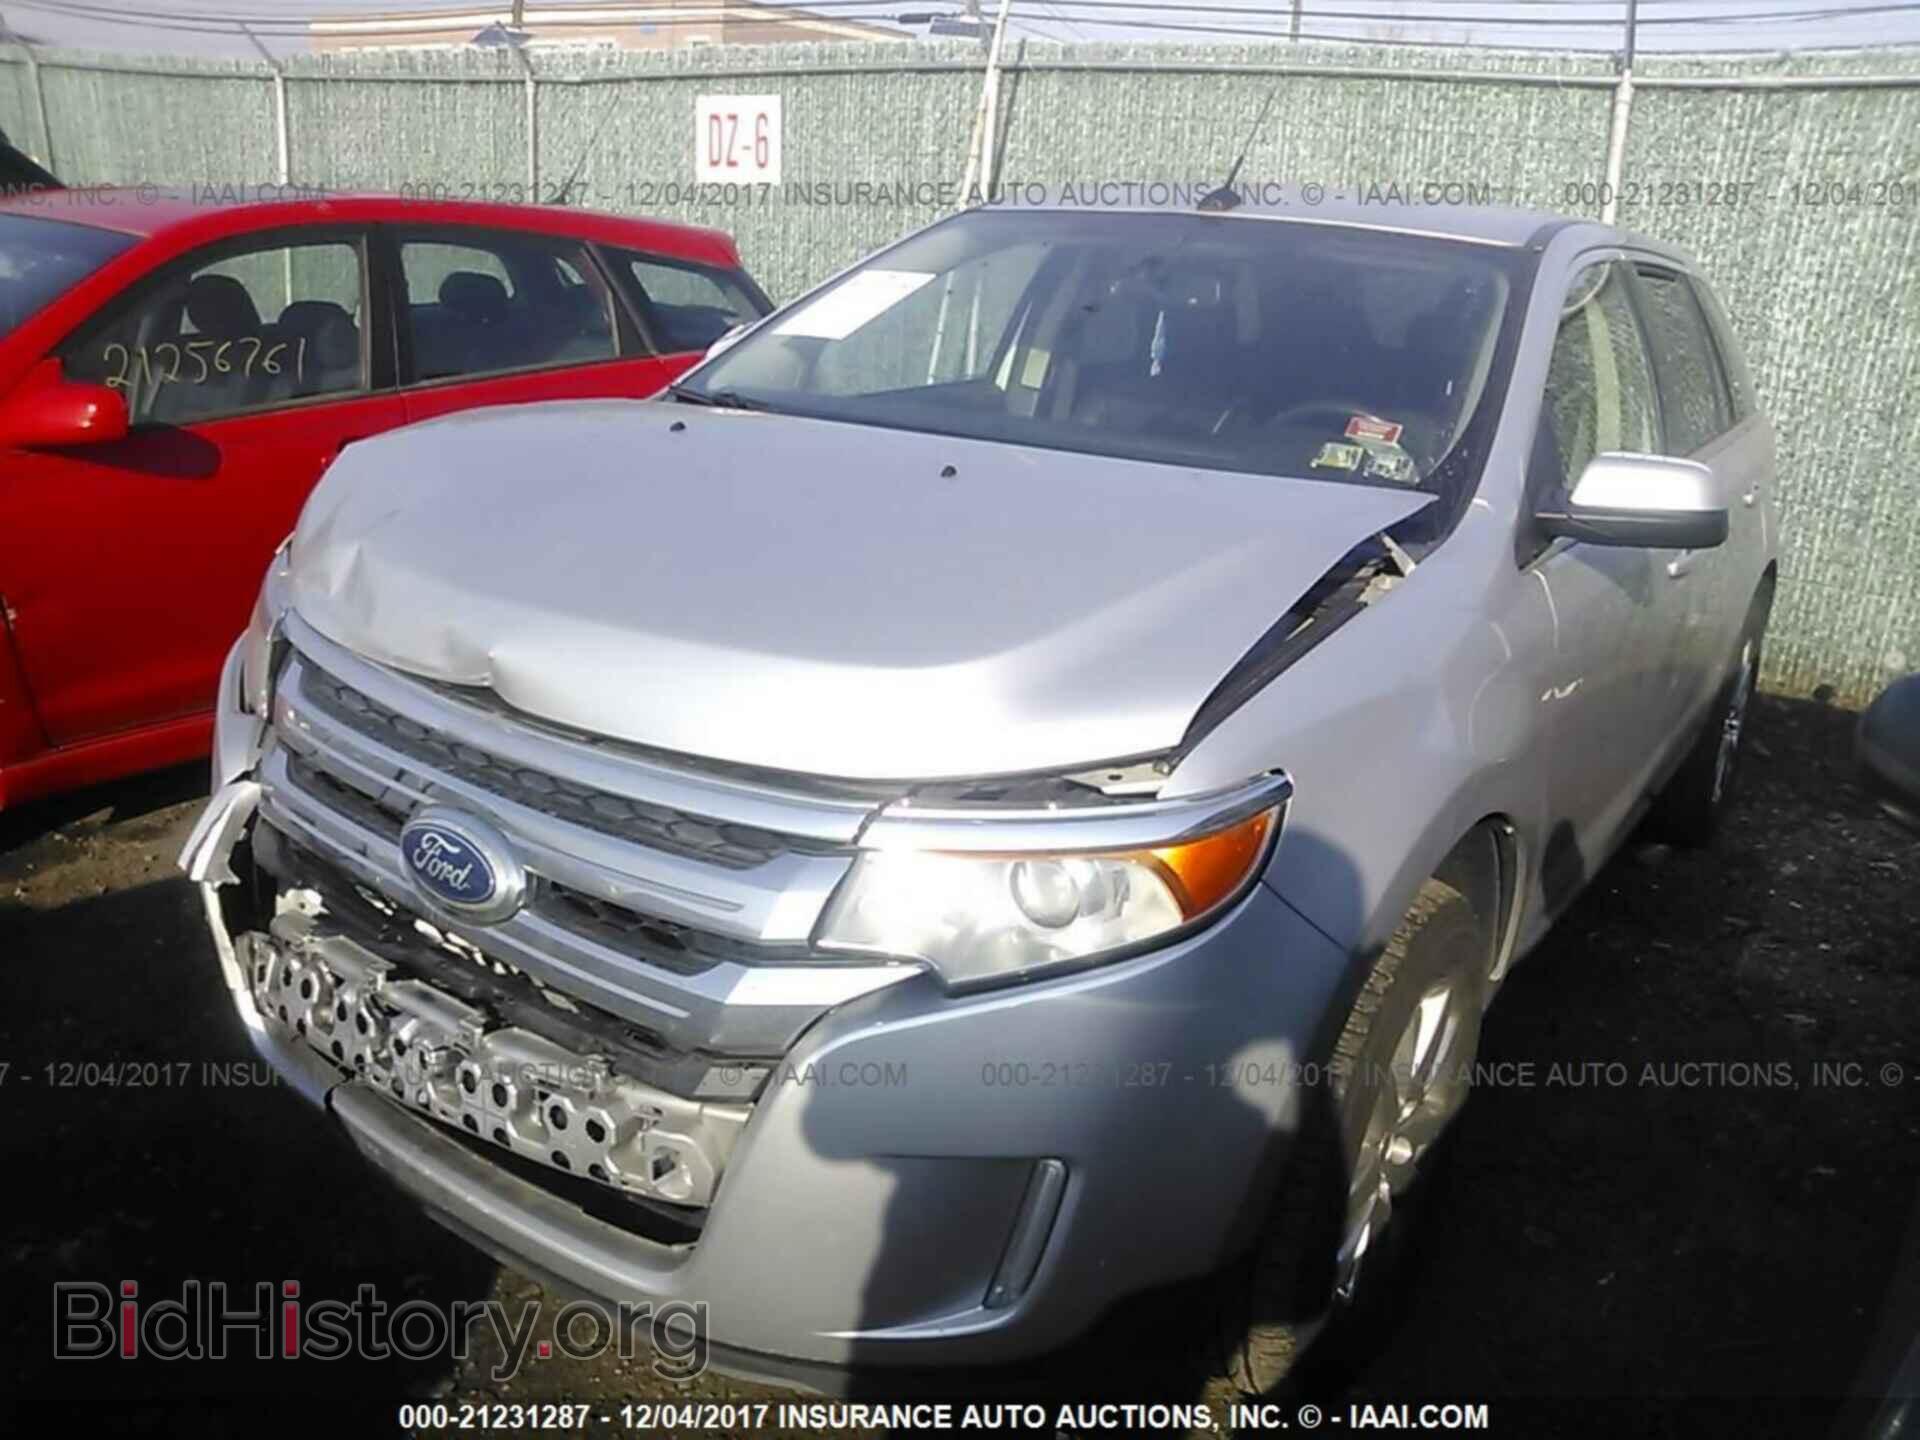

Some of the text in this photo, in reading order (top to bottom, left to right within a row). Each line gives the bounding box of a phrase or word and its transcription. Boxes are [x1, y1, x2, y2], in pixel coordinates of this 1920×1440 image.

[708, 113, 769, 168] DZ-6
[103, 337, 306, 388] 21256761
[412, 832, 474, 891] Ford
